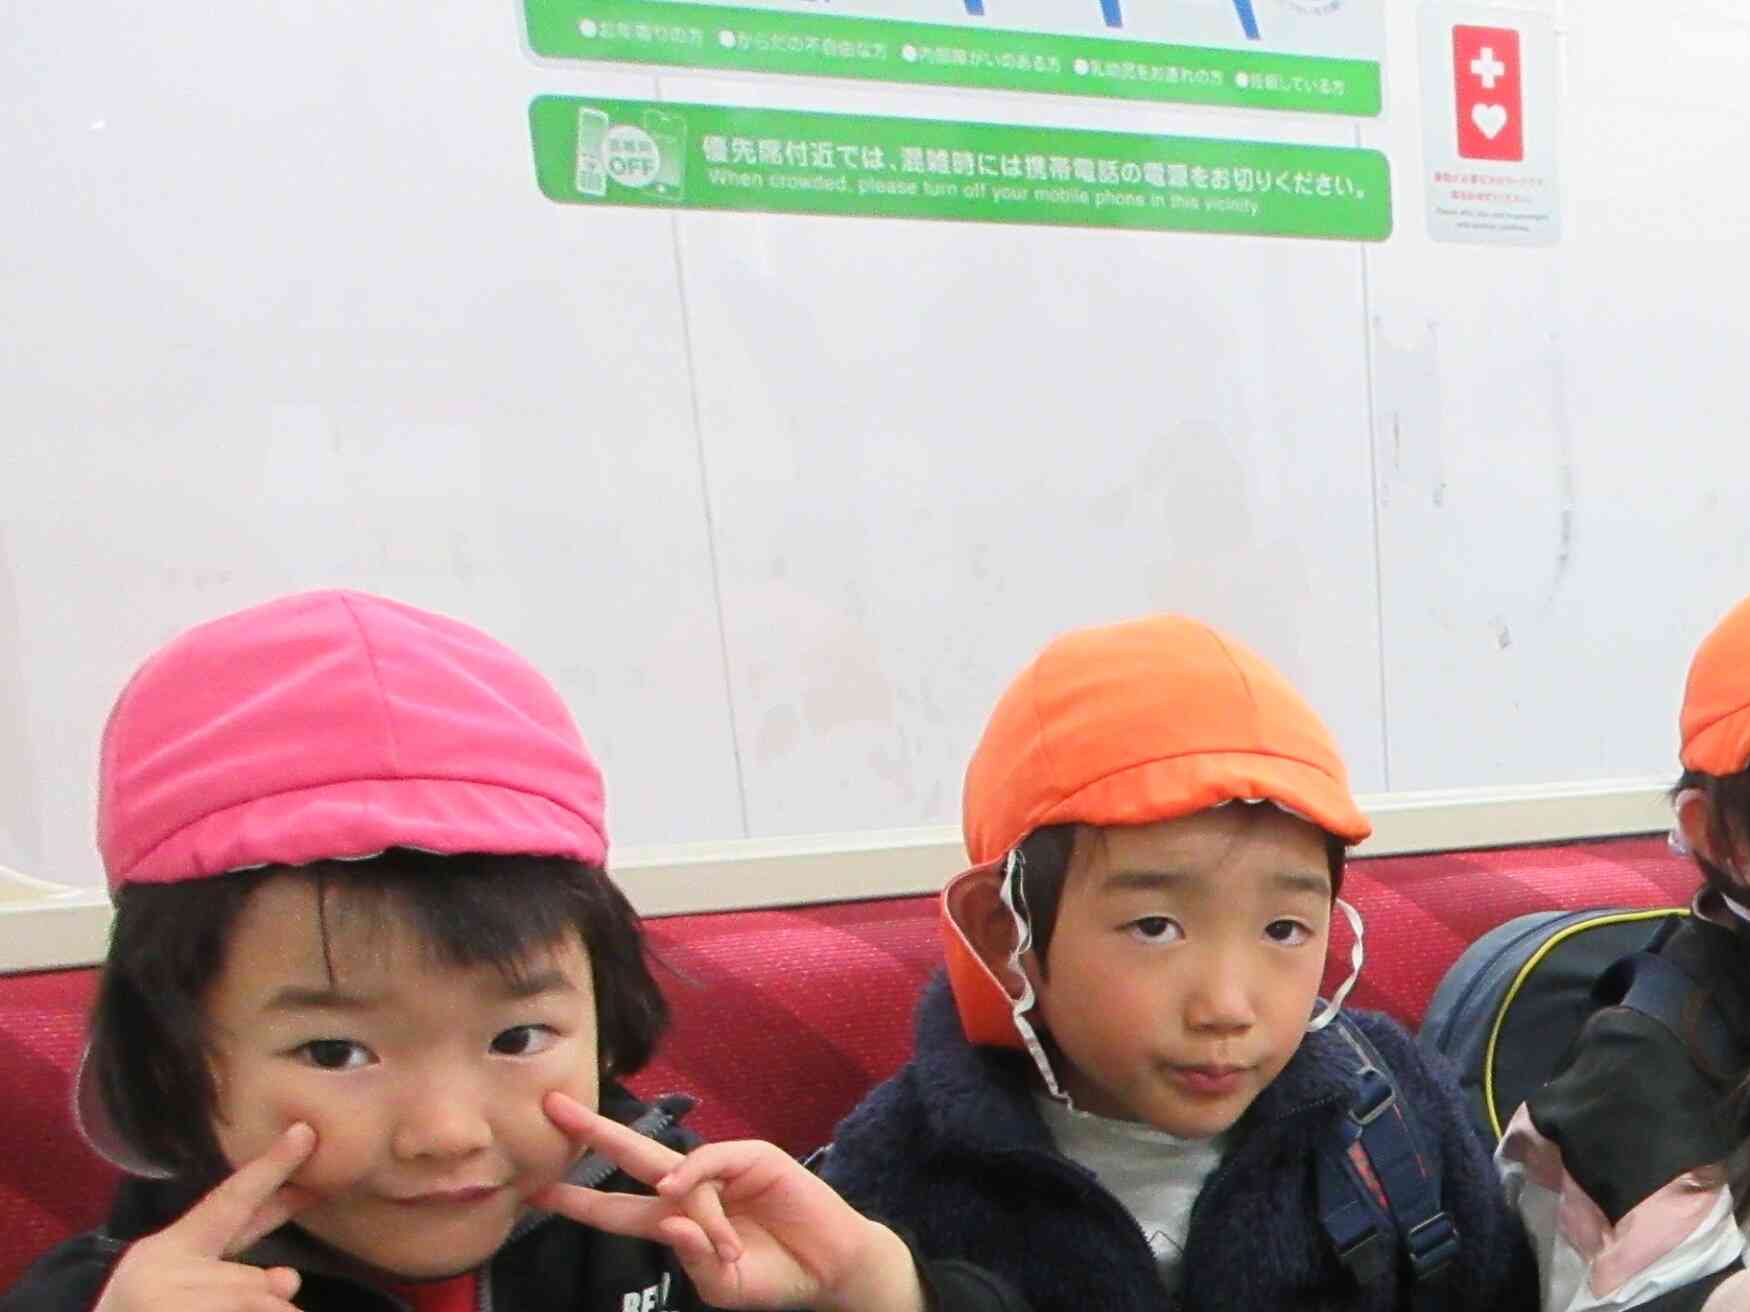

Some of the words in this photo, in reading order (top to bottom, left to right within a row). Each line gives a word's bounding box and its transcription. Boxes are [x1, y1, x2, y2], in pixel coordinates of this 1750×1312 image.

[608, 156, 655, 175] OFF
[708, 168, 763, 188] When
[857, 176, 919, 197] please
[923, 180, 958, 197] turn
[963, 182, 986, 198] off
[992, 187, 1029, 205] your
[1034, 186, 1090, 203] mobile
[1095, 190, 1145, 209] phone
[1151, 192, 1167, 207] in
